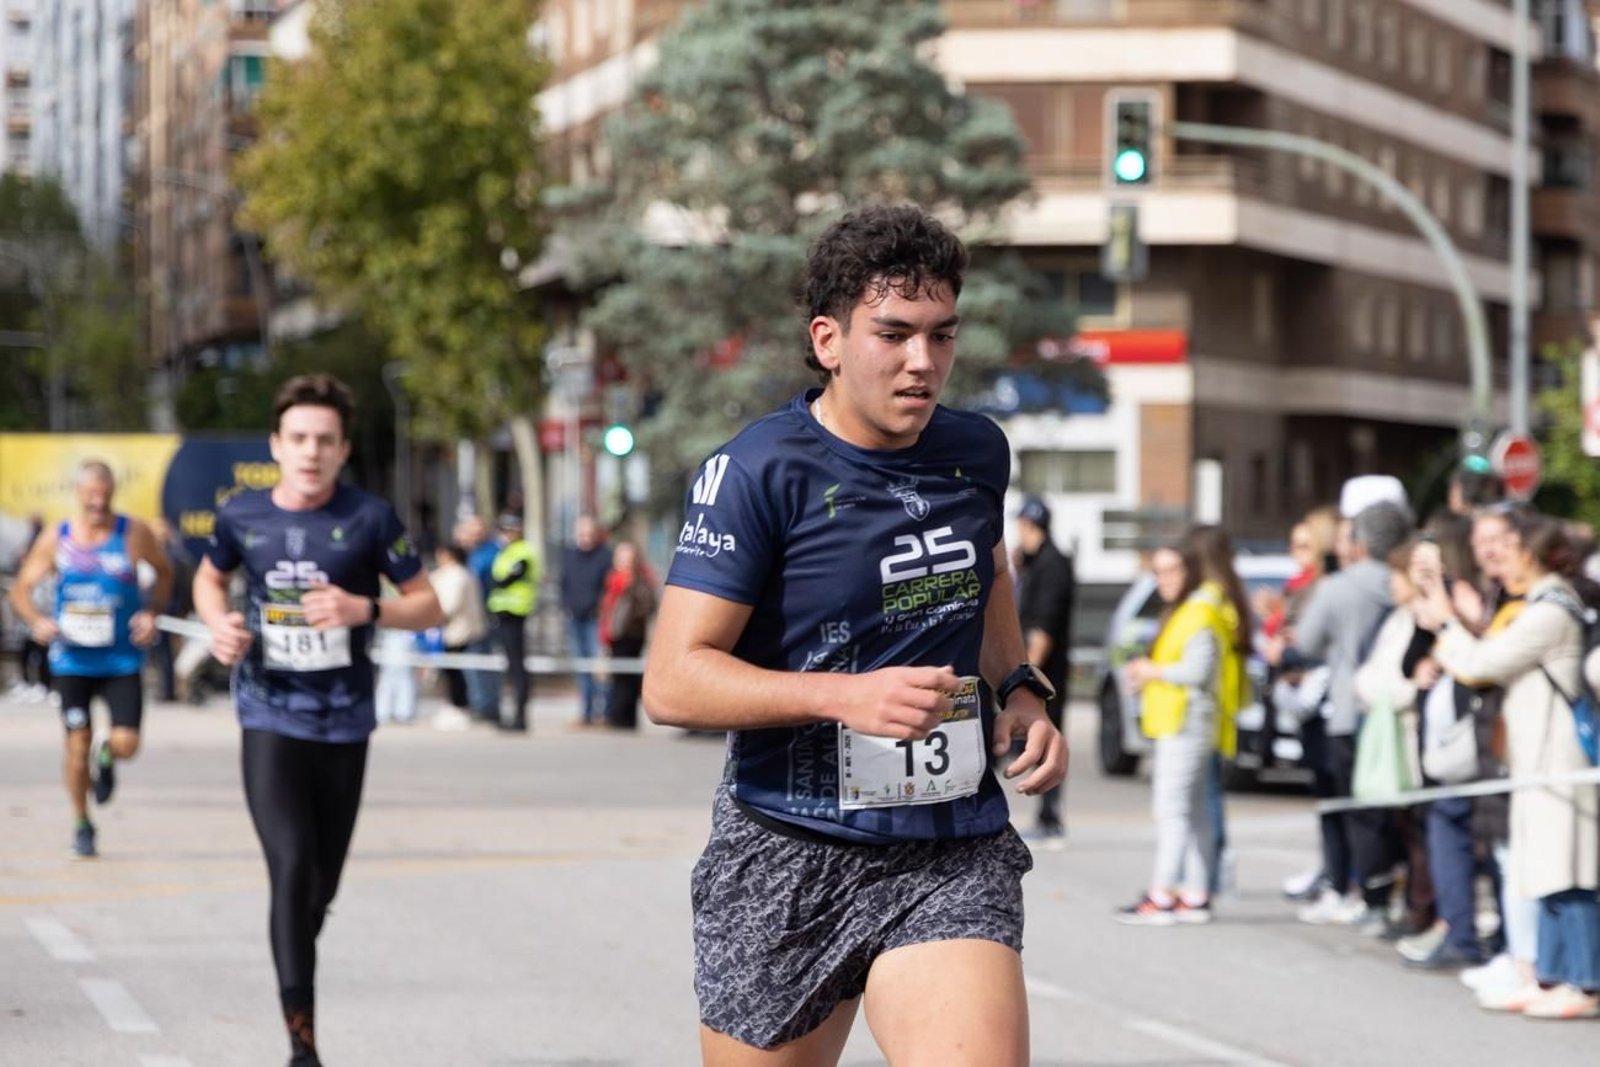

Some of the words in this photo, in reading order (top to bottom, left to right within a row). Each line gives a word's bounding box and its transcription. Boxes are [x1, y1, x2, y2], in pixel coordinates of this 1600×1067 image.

[880, 526, 977, 584] 25
[265, 561, 329, 590] 25
[882, 569, 979, 599] CARRERA
[883, 583, 981, 614] POPULAR
[284, 631, 328, 654] 181
[820, 621, 851, 644] IES
[895, 731, 950, 777] 13
[795, 740, 814, 800] SANTA
[820, 773, 838, 800] DE
